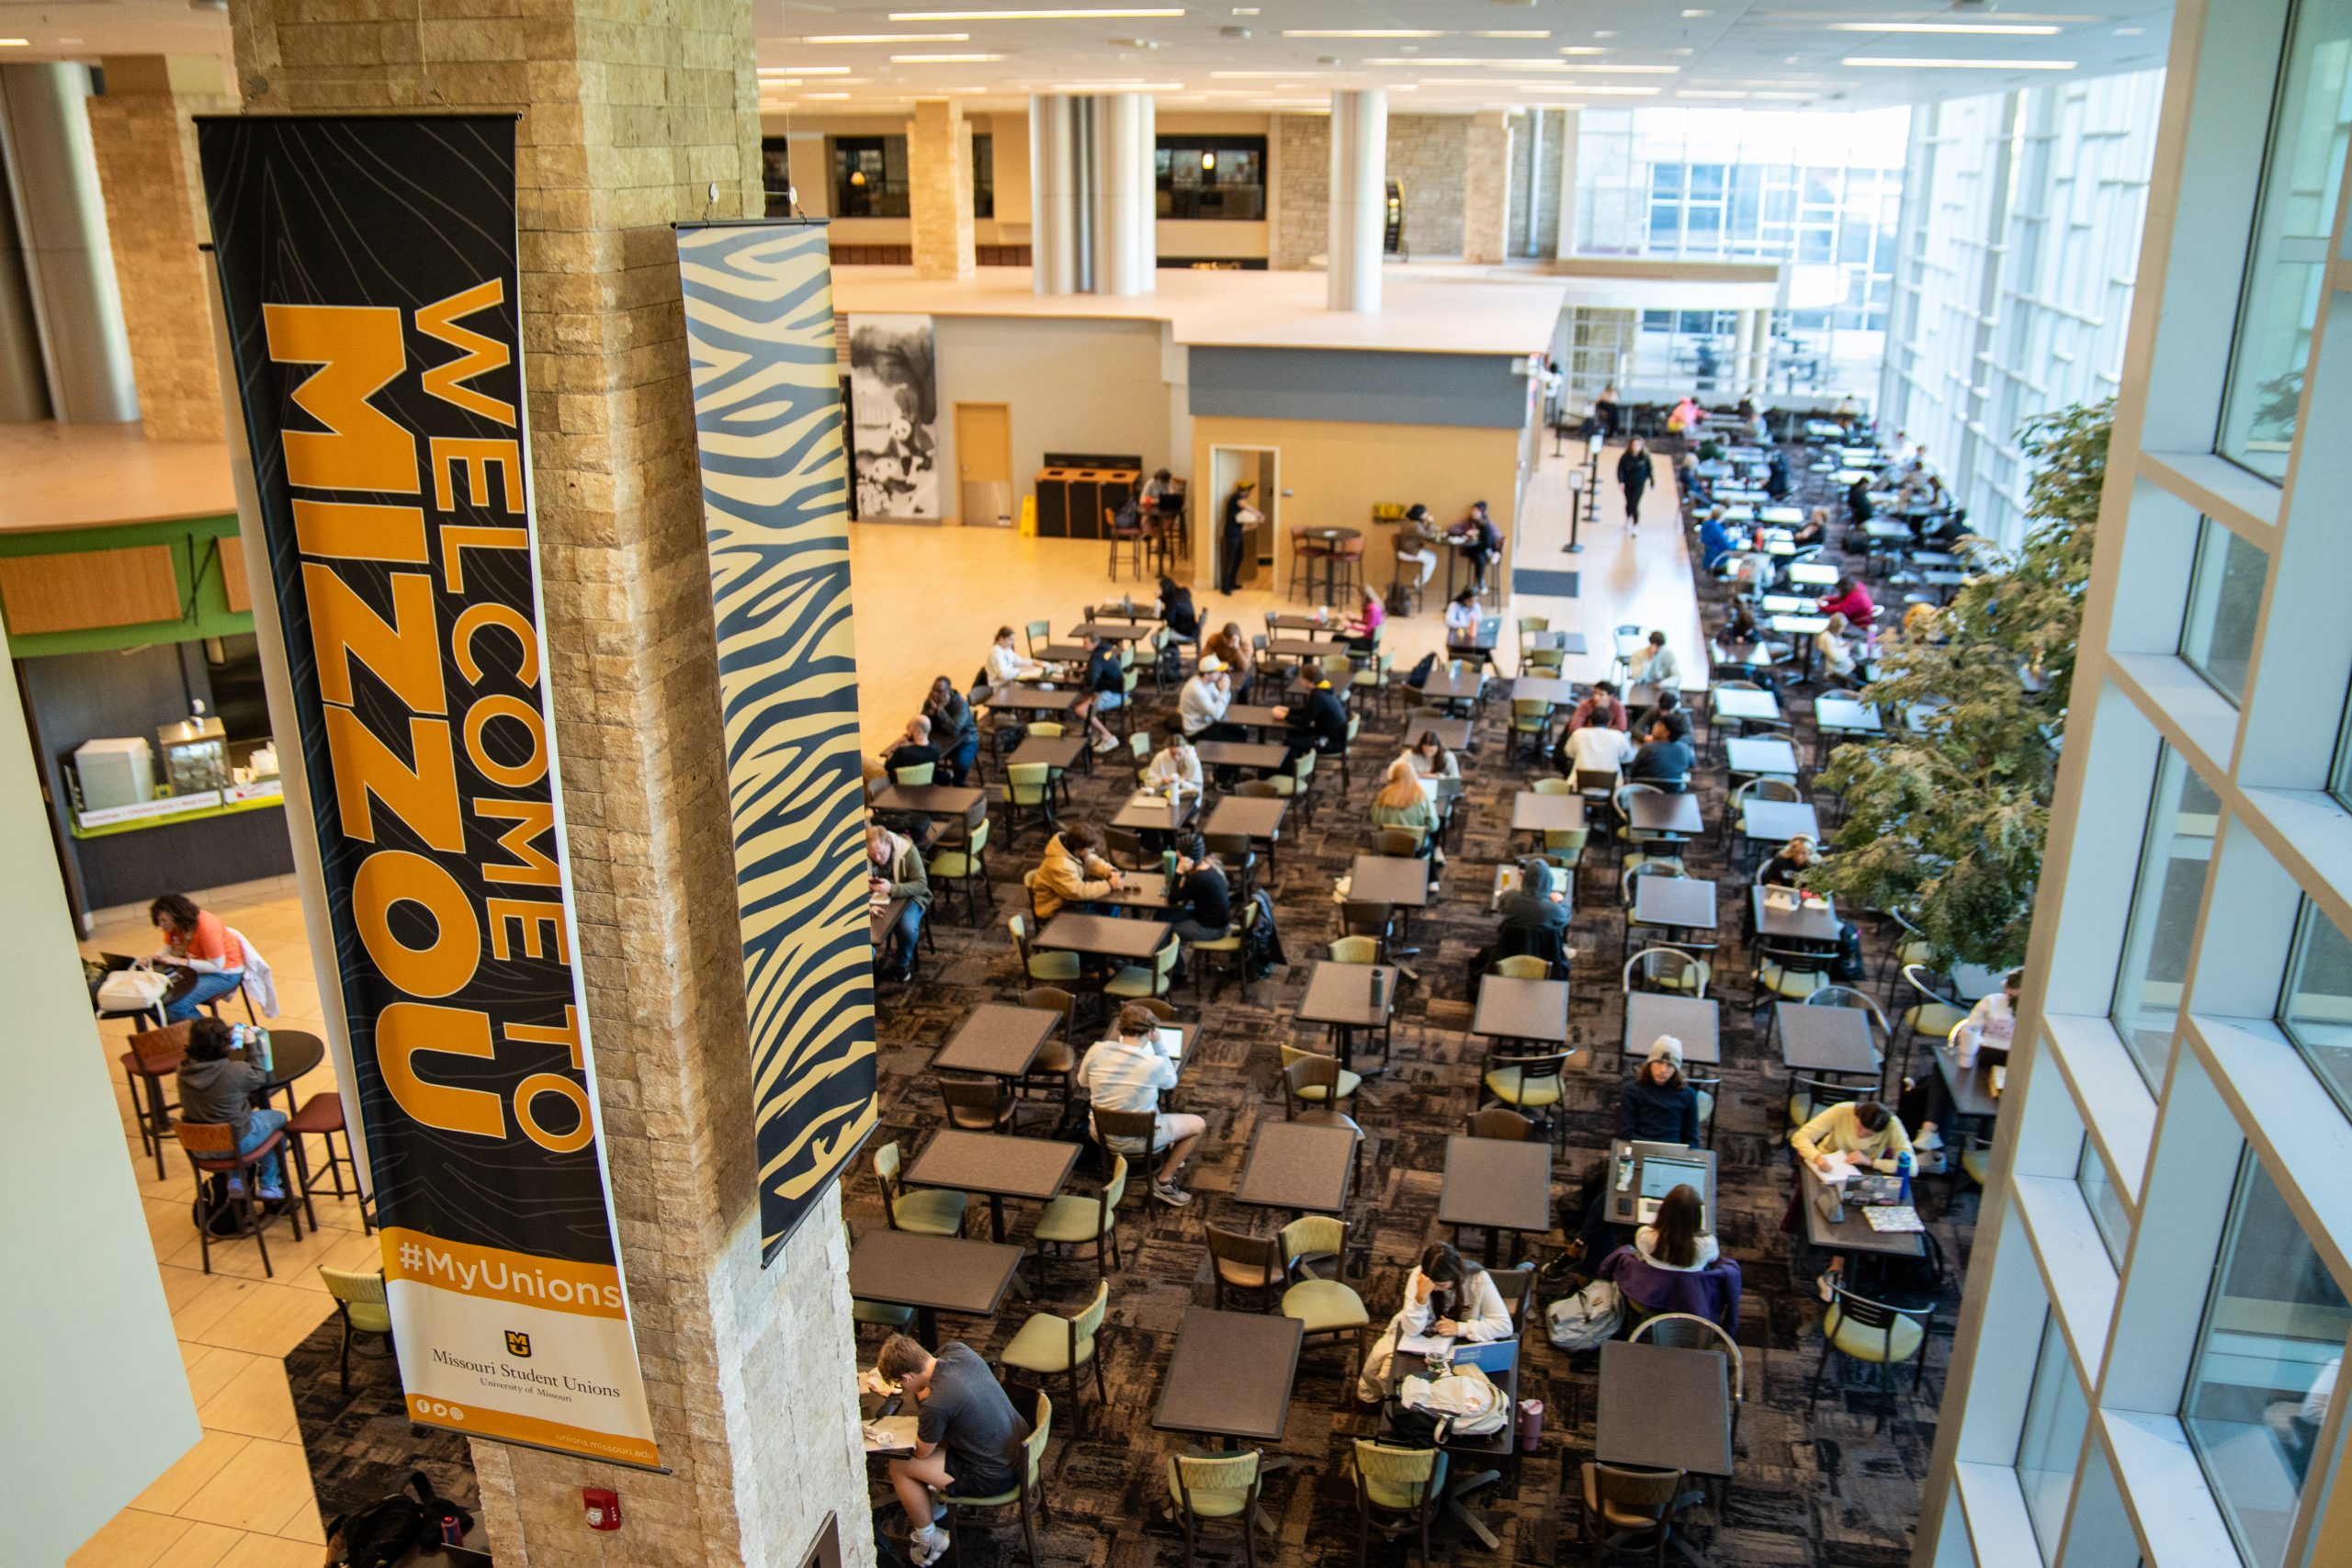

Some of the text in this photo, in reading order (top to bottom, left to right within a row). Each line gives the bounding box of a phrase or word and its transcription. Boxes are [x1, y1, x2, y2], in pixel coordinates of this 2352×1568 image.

[262, 303, 507, 1140] MIZZOU
[415, 276, 594, 1153] WELCOME TO
[399, 1242, 622, 1309] #MyUnions
[431, 1348, 621, 1398] Missouri Student Unions
[480, 1379, 572, 1403] University of Missouri
[556, 1434, 654, 1460] unions.missouri.edu
